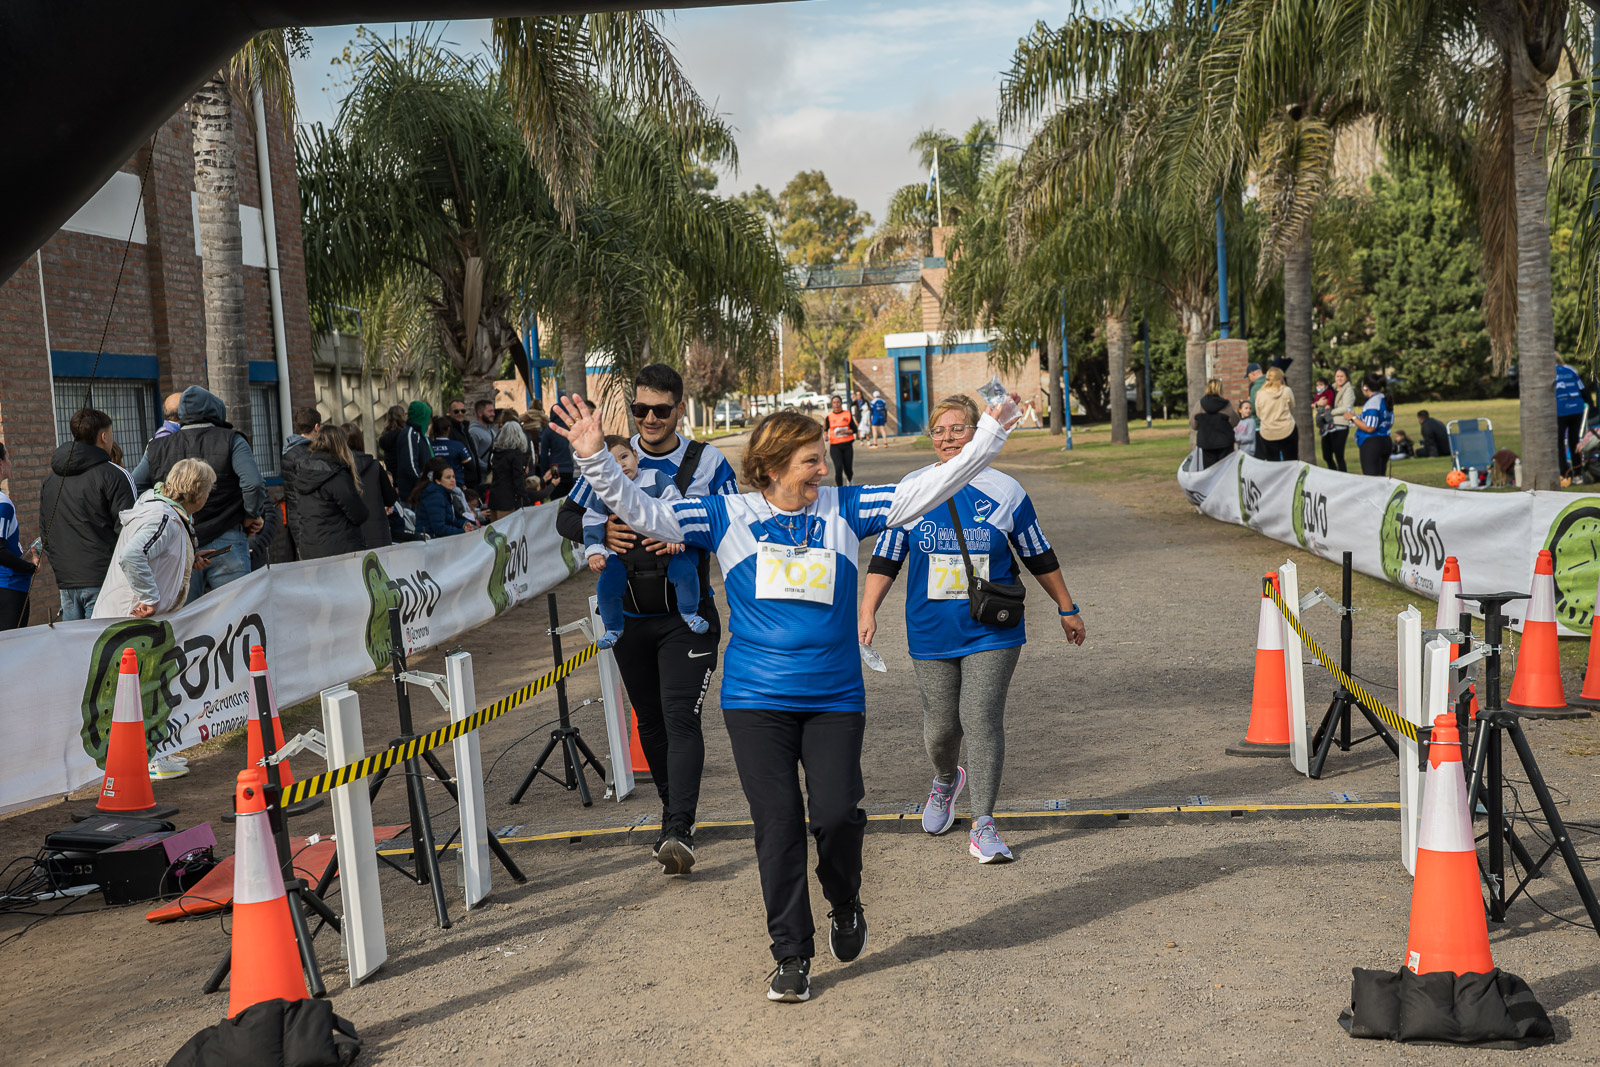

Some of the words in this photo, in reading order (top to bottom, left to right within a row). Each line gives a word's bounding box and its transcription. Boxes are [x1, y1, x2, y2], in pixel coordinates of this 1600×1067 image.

[918, 520, 937, 553] 3
[937, 526, 991, 541] MAATÓN
[765, 558, 827, 590] 702
[935, 567, 976, 590] 71
[206, 690, 249, 719] @cronora
